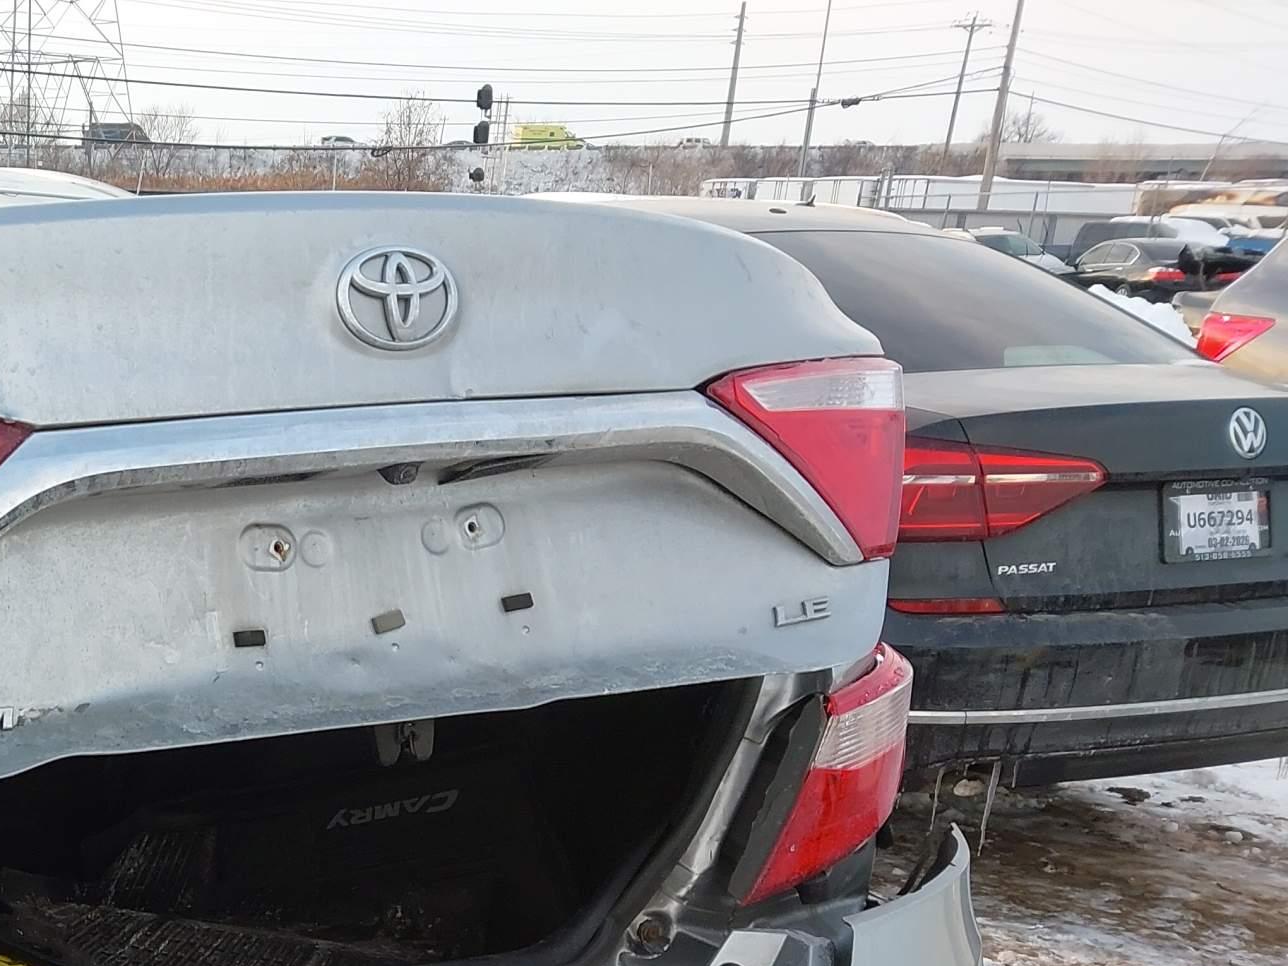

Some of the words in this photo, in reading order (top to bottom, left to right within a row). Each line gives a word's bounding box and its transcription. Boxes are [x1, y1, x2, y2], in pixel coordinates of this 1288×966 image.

[1229, 407, 1267, 459] VW
[1187, 508, 1254, 529] U667294
[997, 562, 1057, 575] PASSAT
[772, 596, 832, 628] LE
[326, 788, 460, 830] CAMRY
